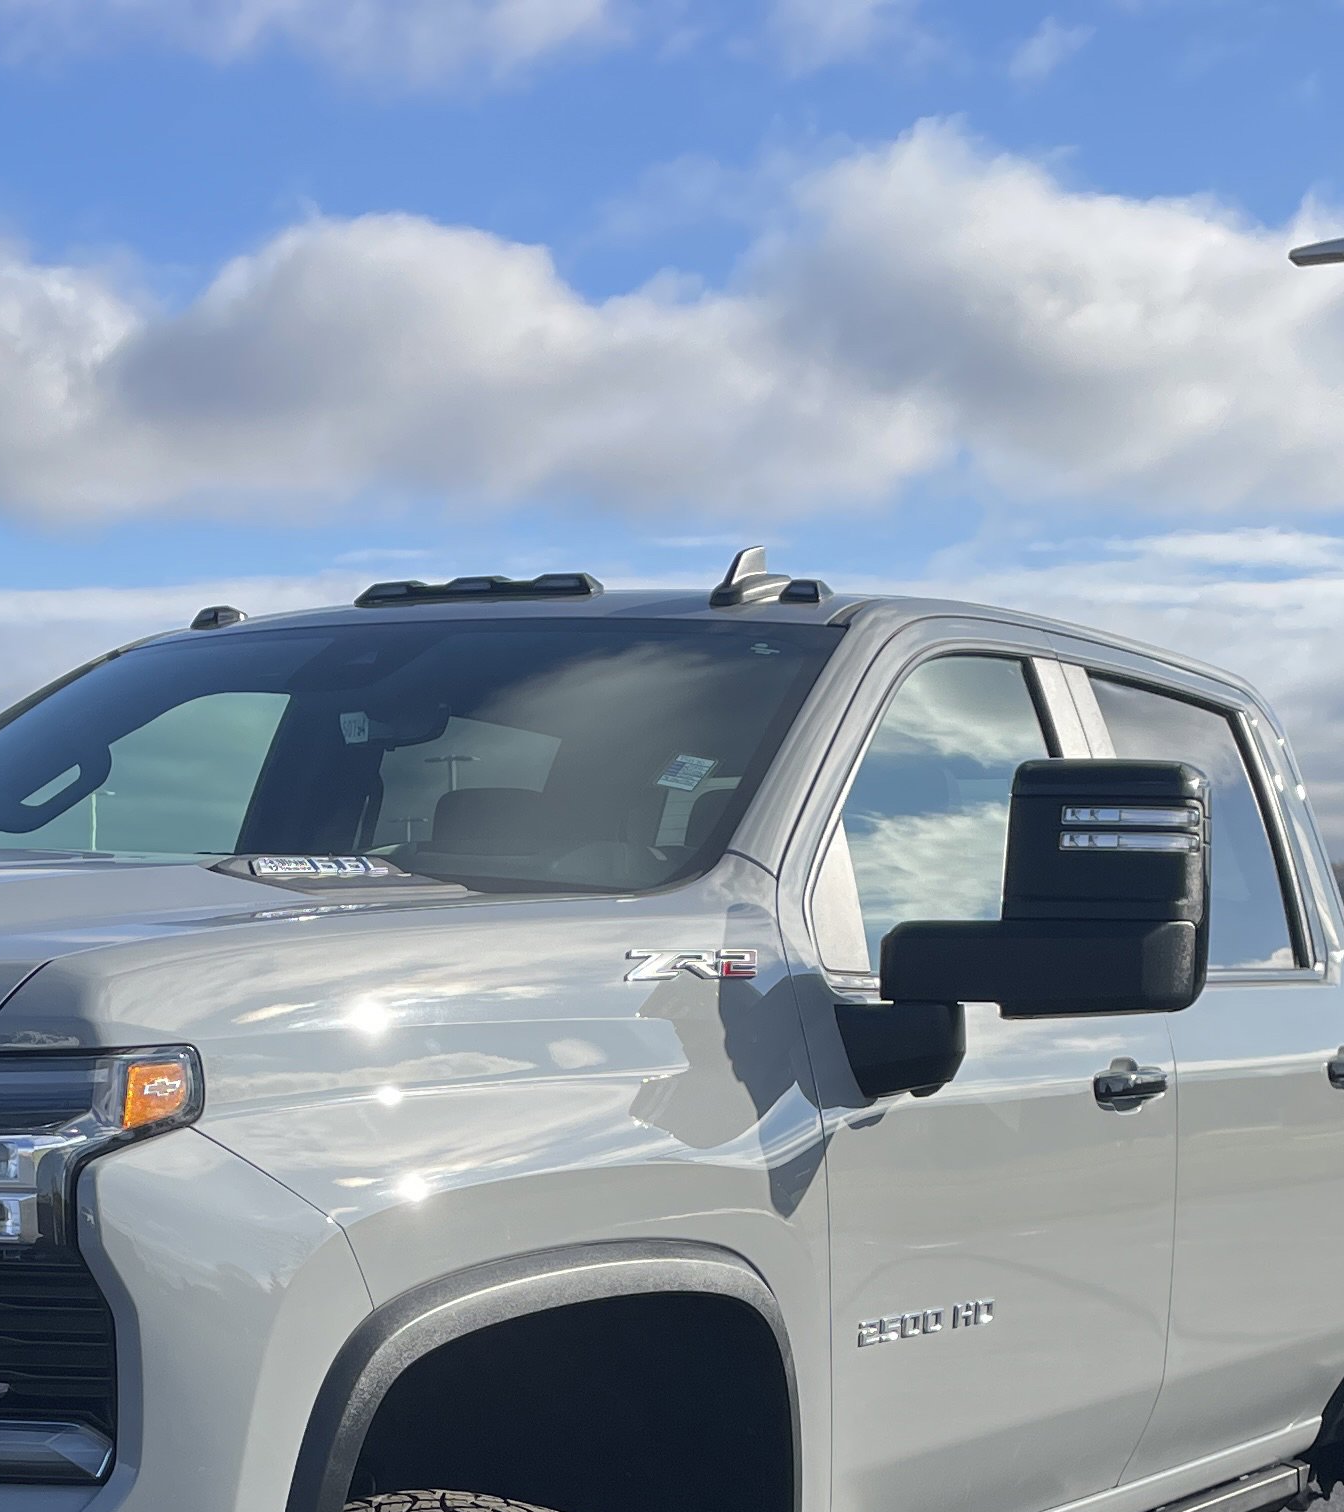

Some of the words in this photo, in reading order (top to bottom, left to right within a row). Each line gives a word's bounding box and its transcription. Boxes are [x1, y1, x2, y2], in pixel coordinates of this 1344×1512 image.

[624, 949, 758, 982] ZR2
[858, 1308, 944, 1347] 2500
[952, 1299, 995, 1329] HD
